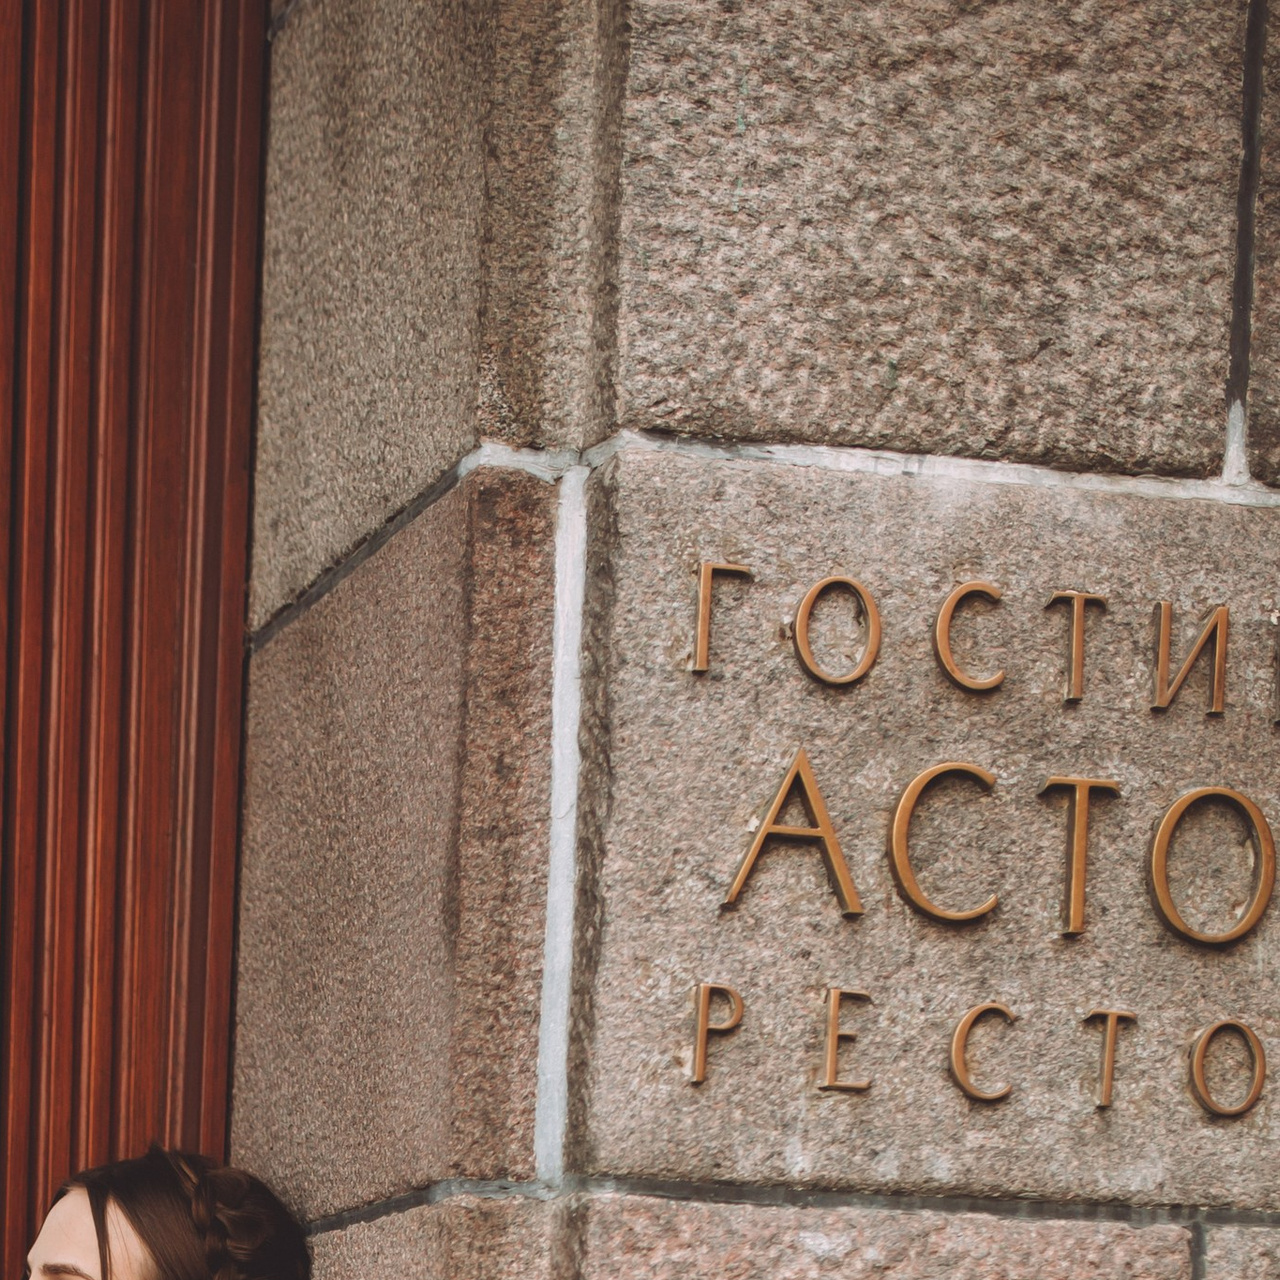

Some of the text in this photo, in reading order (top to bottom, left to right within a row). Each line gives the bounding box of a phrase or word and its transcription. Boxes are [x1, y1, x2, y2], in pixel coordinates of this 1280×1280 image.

[692, 562, 1280, 724] ГОСТИ
[721, 748, 1277, 944] АСТО
[691, 983, 1268, 1116] РЕСТО
